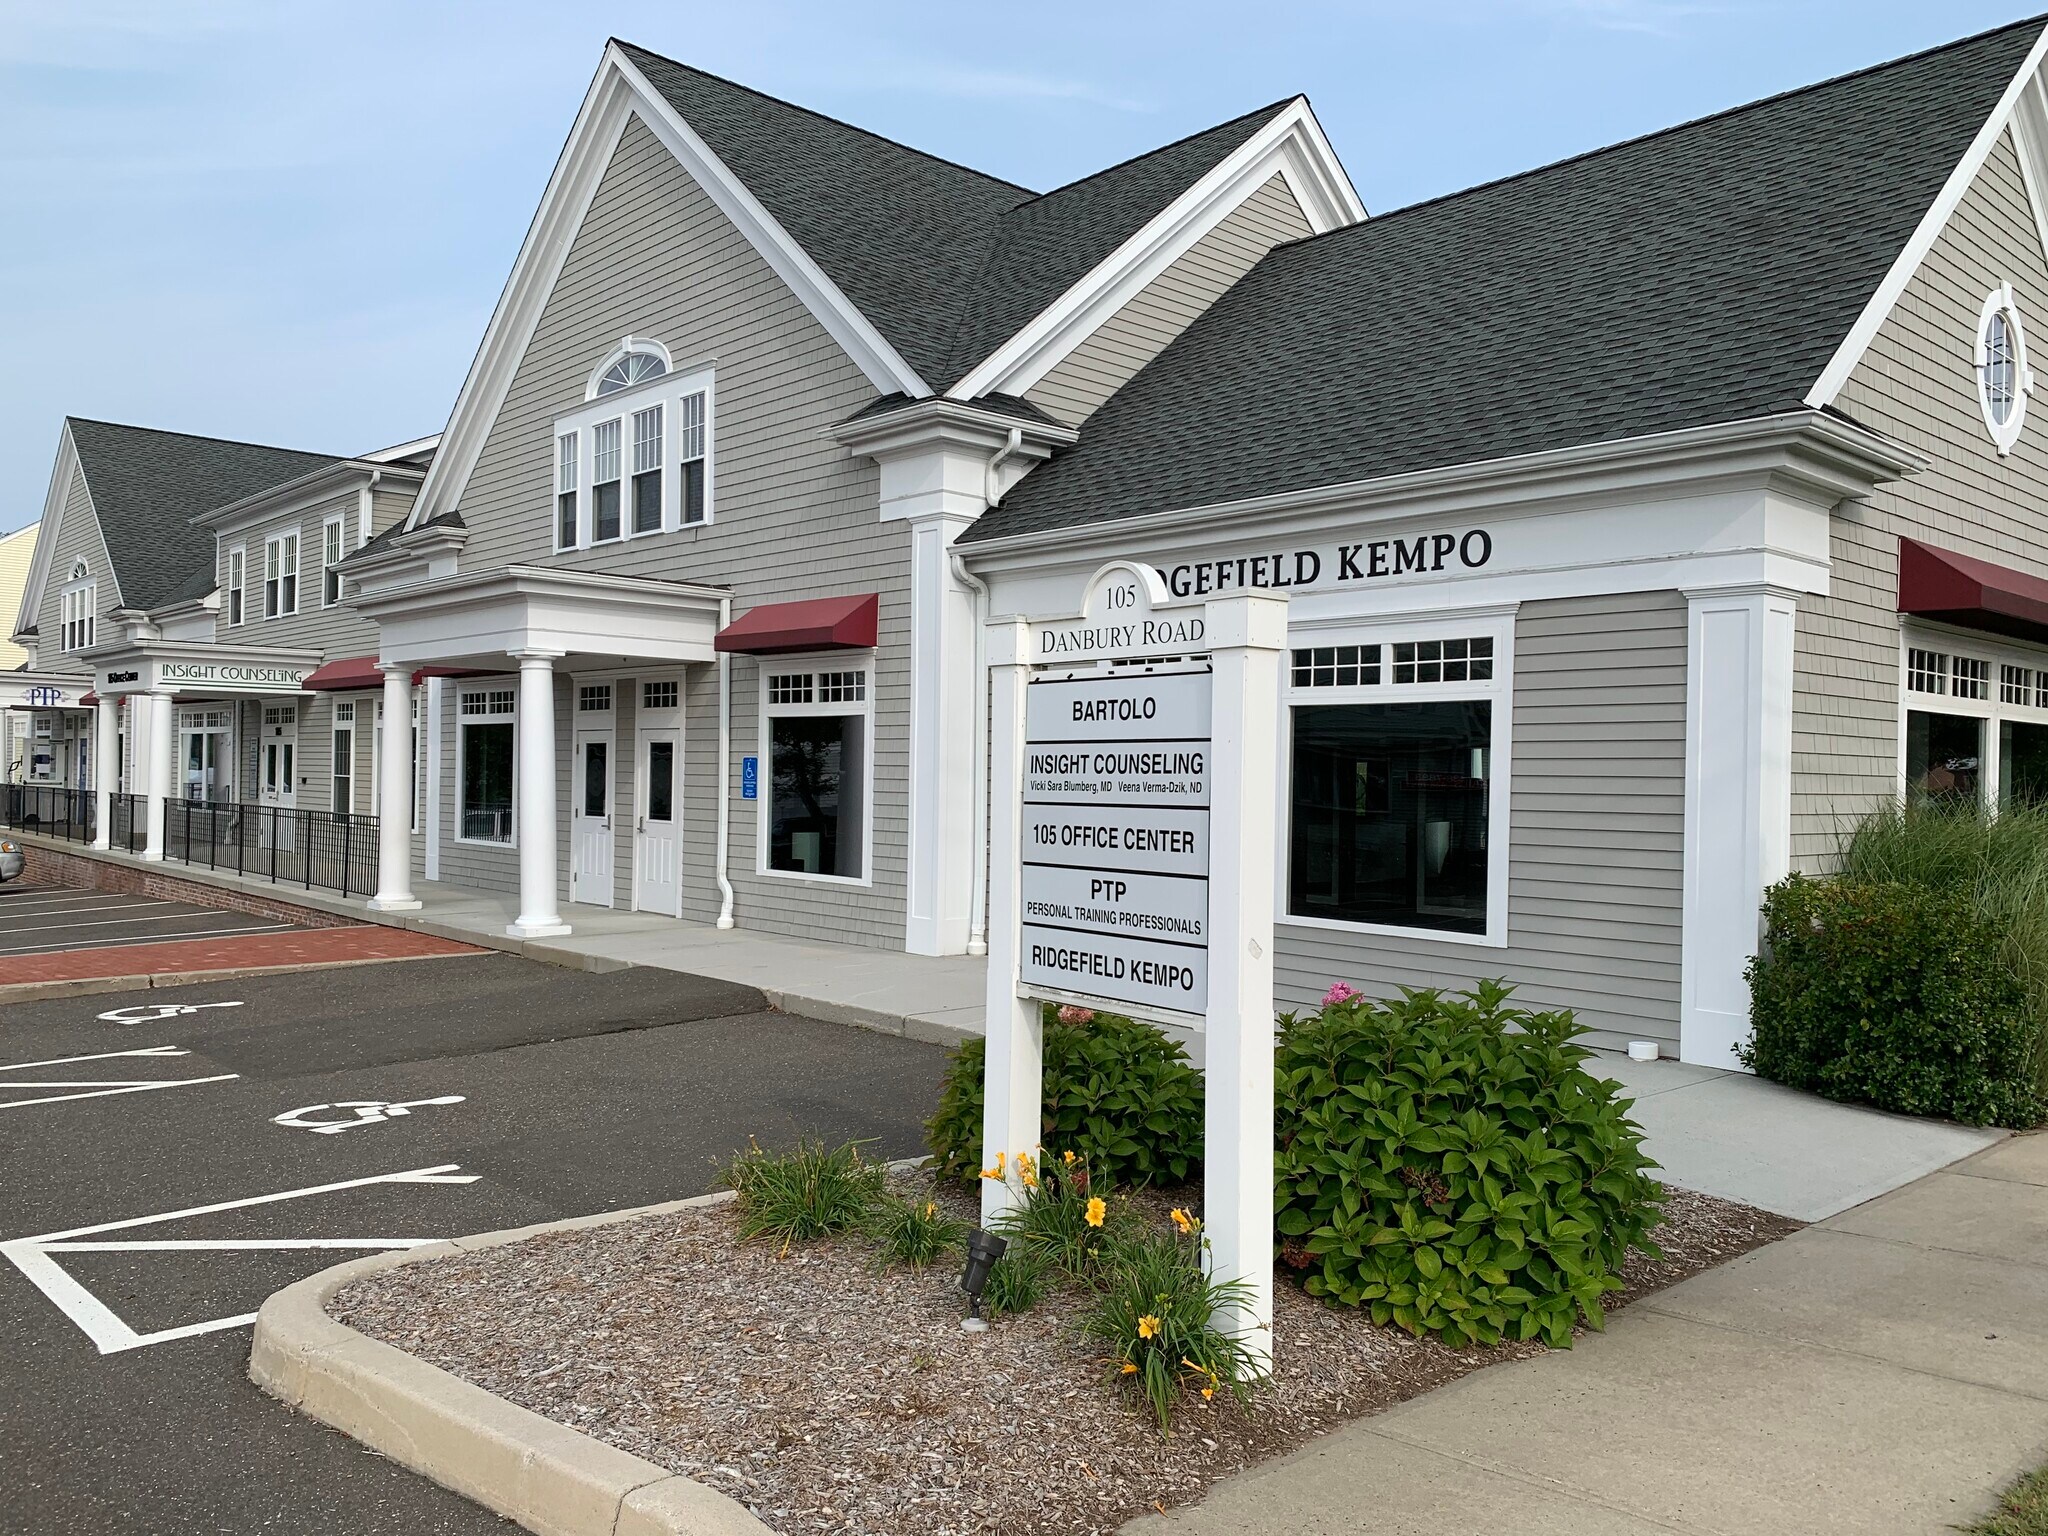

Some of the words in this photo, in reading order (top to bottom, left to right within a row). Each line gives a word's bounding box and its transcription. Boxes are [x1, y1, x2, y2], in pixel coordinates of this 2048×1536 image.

[1337, 529, 1492, 581] KEMPO
[1107, 585, 1136, 610] 105
[1041, 625, 1136, 654] DANBURY
[1142, 619, 1205, 646] ROAD
[30, 686, 62, 706] PTP
[1072, 696, 1157, 722] BARTOLO
[1030, 754, 1090, 775] INSIGHT
[1094, 753, 1204, 775] COUNSELING
[1030, 780, 1046, 791] Vicki
[1047, 780, 1063, 792] Sara
[1064, 781, 1099, 795] Blumberg,
[1100, 781, 1113, 792] MD
[1118, 781, 1141, 793] Veena
[1142, 781, 1188, 795] Verma-Dzik,
[1189, 782, 1203, 794] ND
[1033, 824, 1057, 845] 105
[1061, 824, 1119, 849] OFFICE
[1123, 828, 1195, 854] CENTER
[1091, 879, 1127, 902] PTP
[1027, 901, 1073, 920] PERSONAL
[1074, 907, 1117, 925] TRAINING
[1119, 911, 1202, 935] PROFESSIONALS
[1032, 945, 1125, 980] RIDGEFIELD
[1130, 960, 1194, 991] KEMPO
